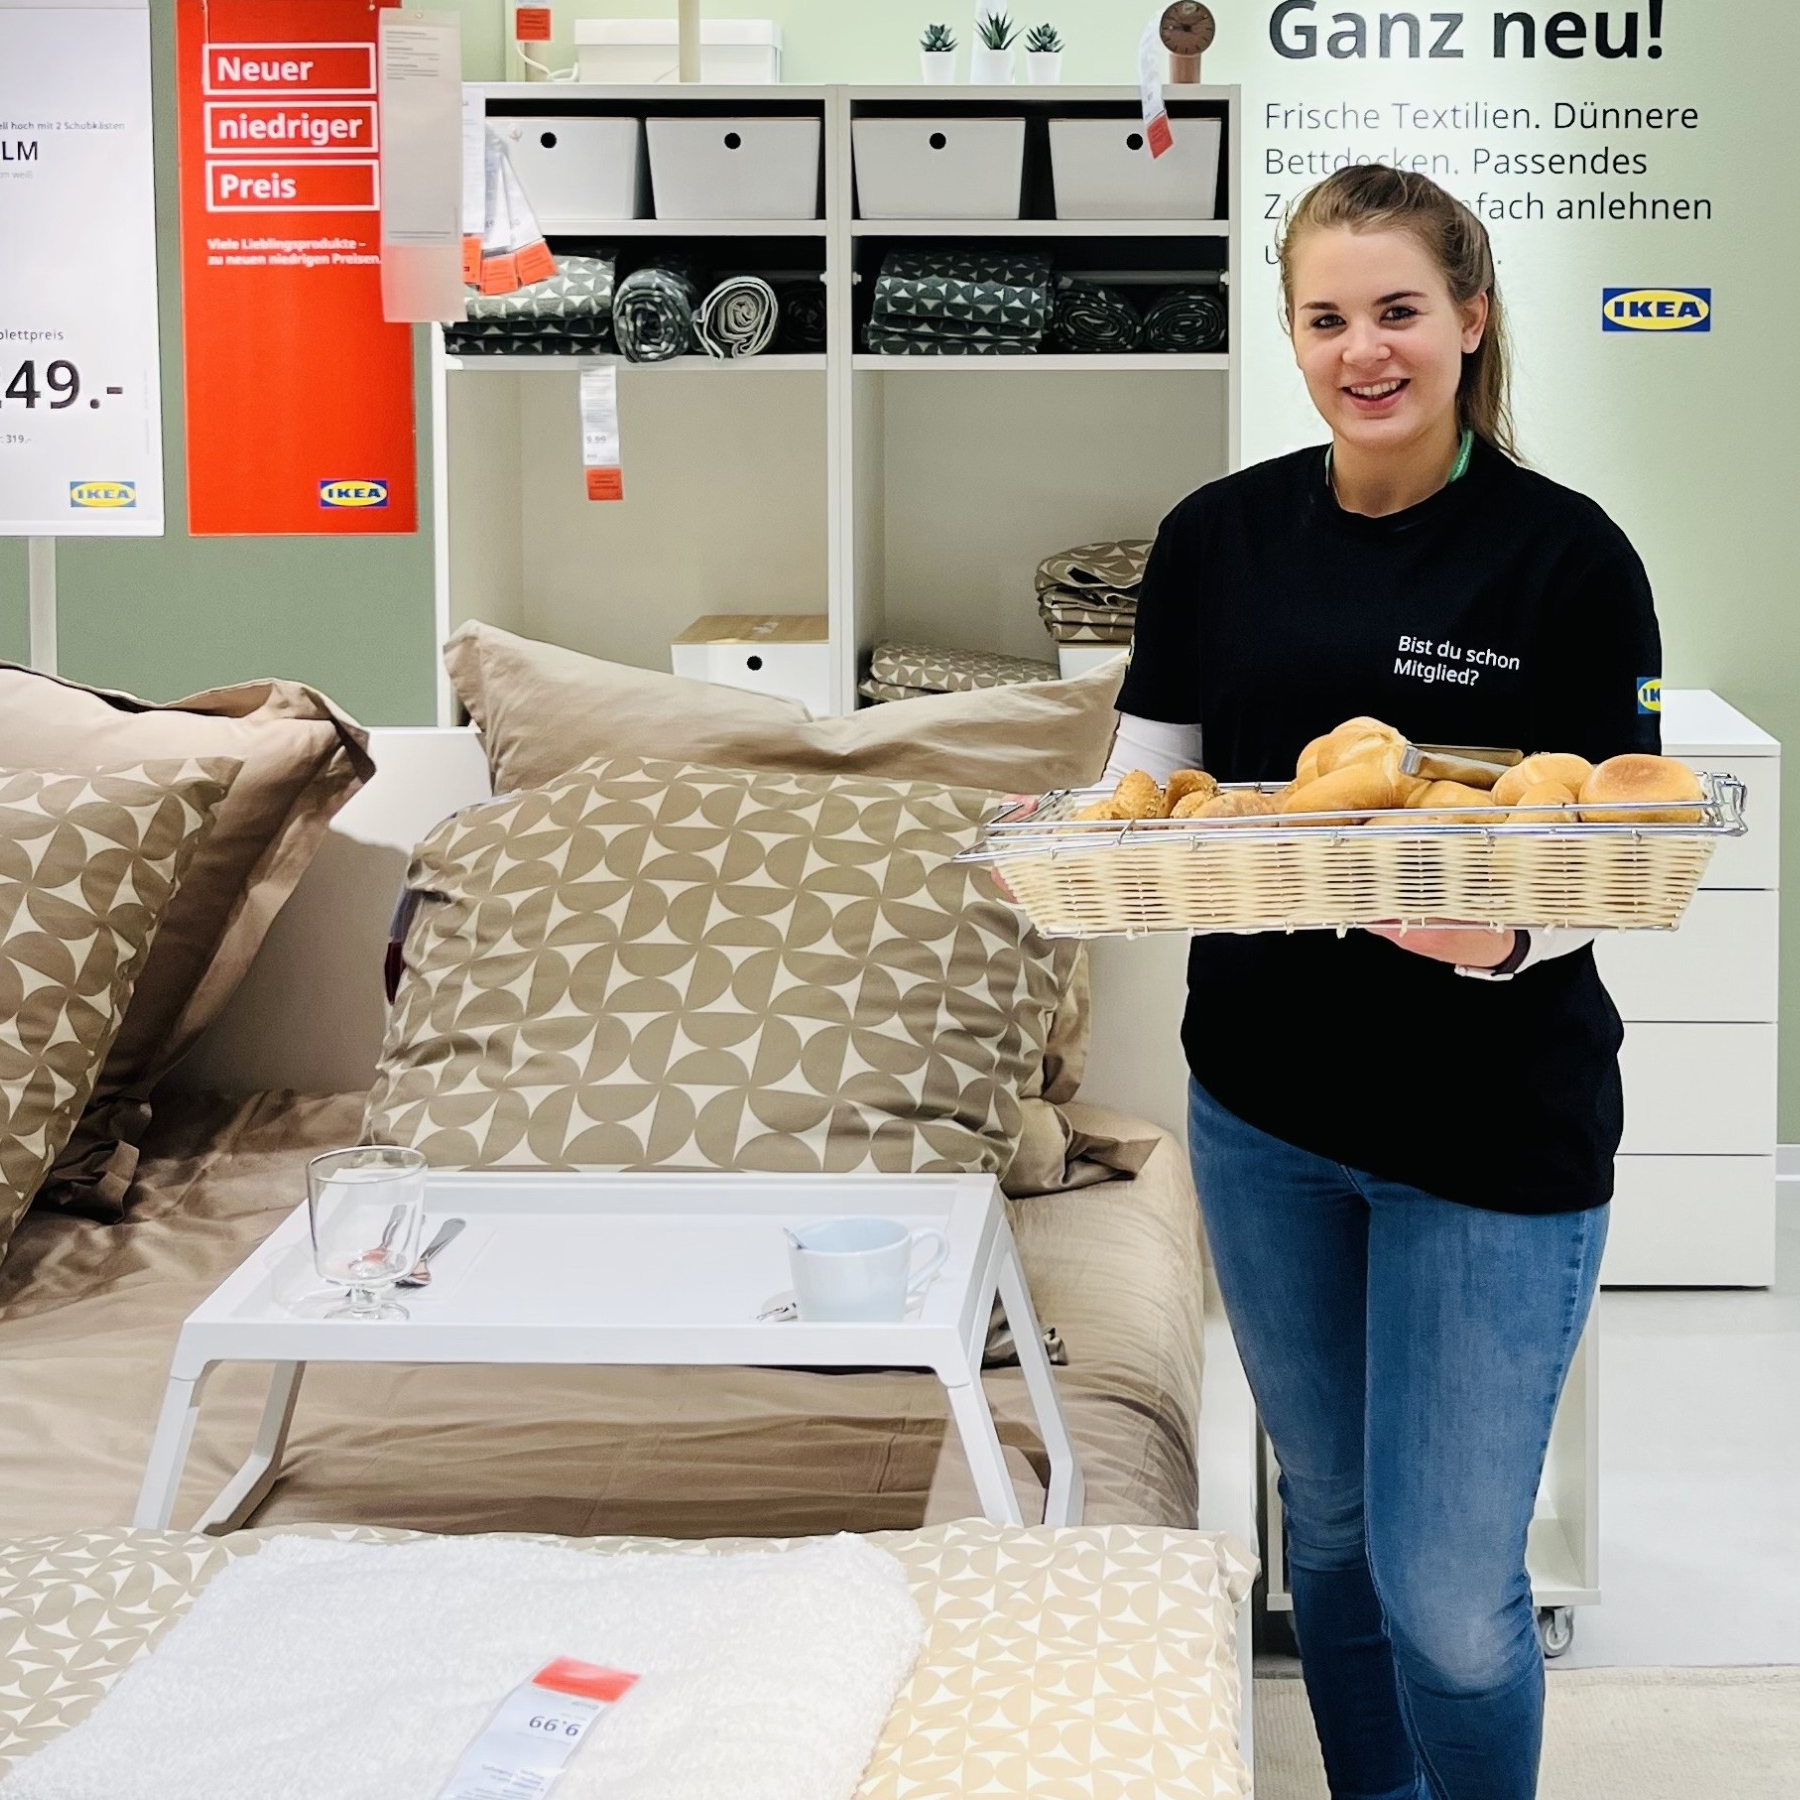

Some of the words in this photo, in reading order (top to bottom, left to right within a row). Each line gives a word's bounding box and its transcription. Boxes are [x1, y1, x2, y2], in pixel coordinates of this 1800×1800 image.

[1269, 0, 1464, 59] Ganz
[1493, 0, 1663, 59] neu!
[217, 57, 314, 81] Neuer
[11, 121, 34, 130] hoch
[37, 121, 54, 130] mit
[56, 121, 62, 130] 2
[1266, 102, 1380, 129] Frische
[1391, 102, 1540, 129] Textilien.
[1555, 102, 1698, 129] Dünnere
[219, 113, 363, 146] niedriger
[2, 141, 38, 160] LM
[1474, 146, 1648, 174] Passendes
[220, 172, 297, 198] Preis
[1557, 191, 1711, 219] anlehnen
[207, 238, 240, 250] Viele
[241, 237, 357, 252] Lieblingsprodukte
[207, 254, 224, 266] zu
[225, 254, 267, 266] neuen
[268, 253, 330, 268] niedrigen
[1614, 301, 1702, 318] IKEA
[0, 360, 124, 409] 49.-
[77, 489, 131, 499] IKEA
[328, 488, 381, 498] IKEA
[1398, 635, 1432, 655] Bist
[1437, 640, 1462, 660] du
[1466, 648, 1521, 670] schon
[1393, 658, 1480, 686] Mitglied?
[528, 1715, 581, 1737] 9.99
